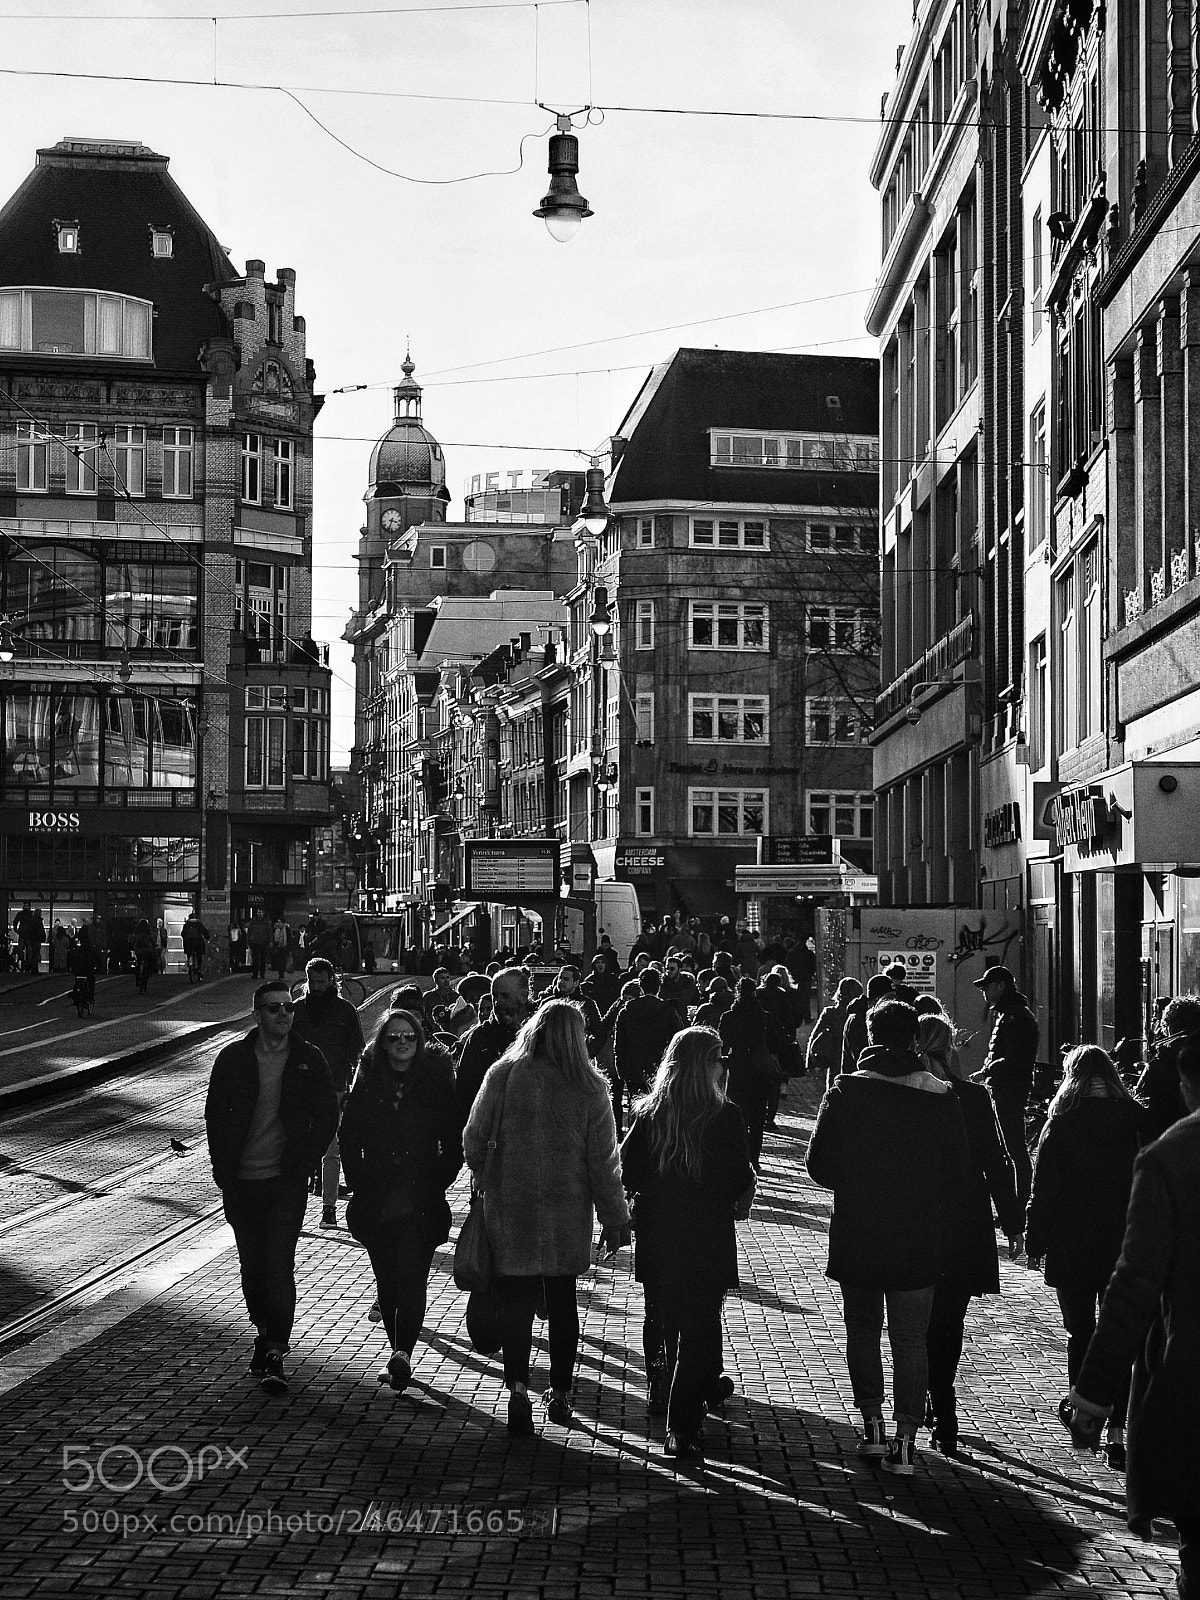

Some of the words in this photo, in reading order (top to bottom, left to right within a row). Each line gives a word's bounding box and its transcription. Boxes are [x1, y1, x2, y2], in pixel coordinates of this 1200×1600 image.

[29, 811, 80, 828] BOSS
[624, 848, 657, 856] AMSTERDAM
[615, 856, 665, 866] CHEESE
[627, 866, 652, 875] COMPANY
